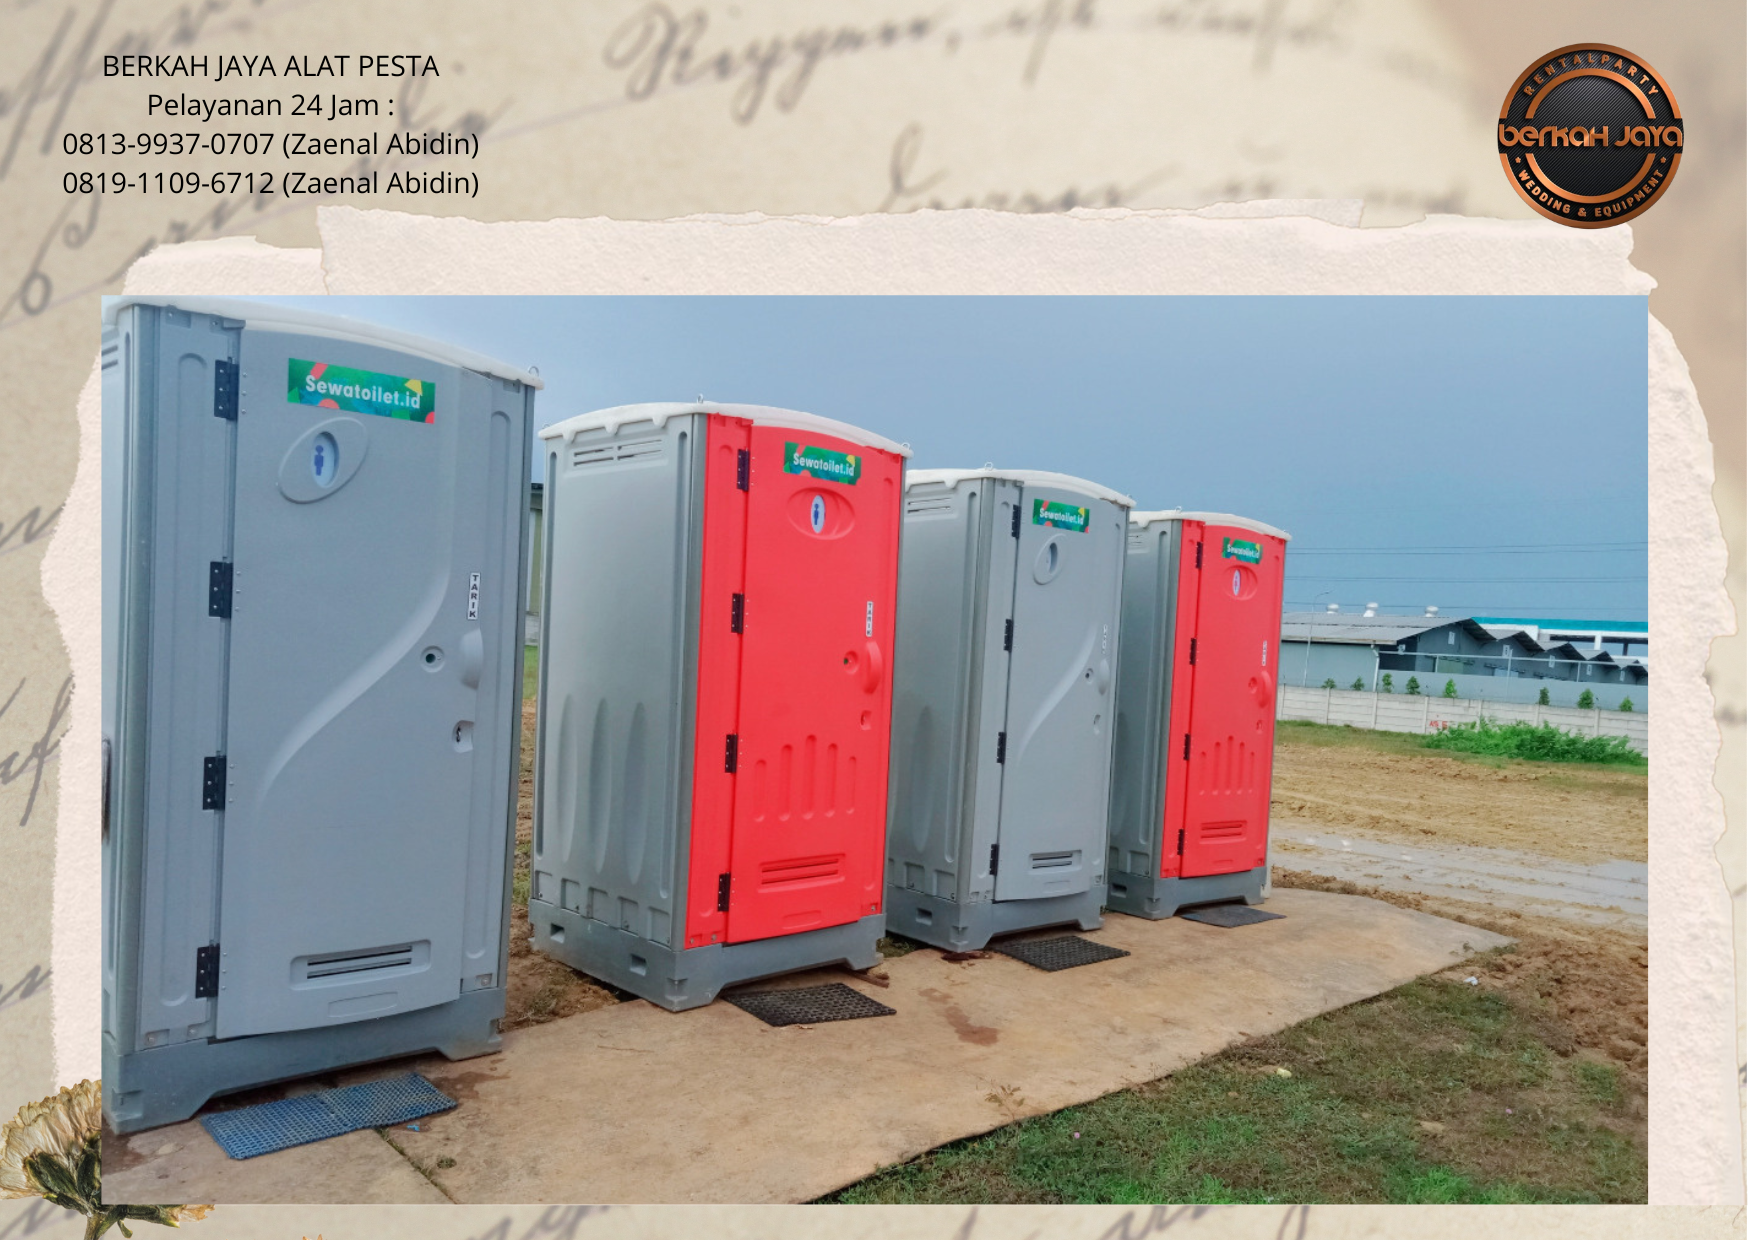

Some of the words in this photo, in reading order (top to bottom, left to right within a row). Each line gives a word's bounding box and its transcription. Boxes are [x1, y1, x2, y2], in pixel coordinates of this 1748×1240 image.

[305, 374, 421, 409] Sewatoilet.id
[793, 452, 855, 477] Sewatoilet.id
[469, 574, 479, 618] TARIK
